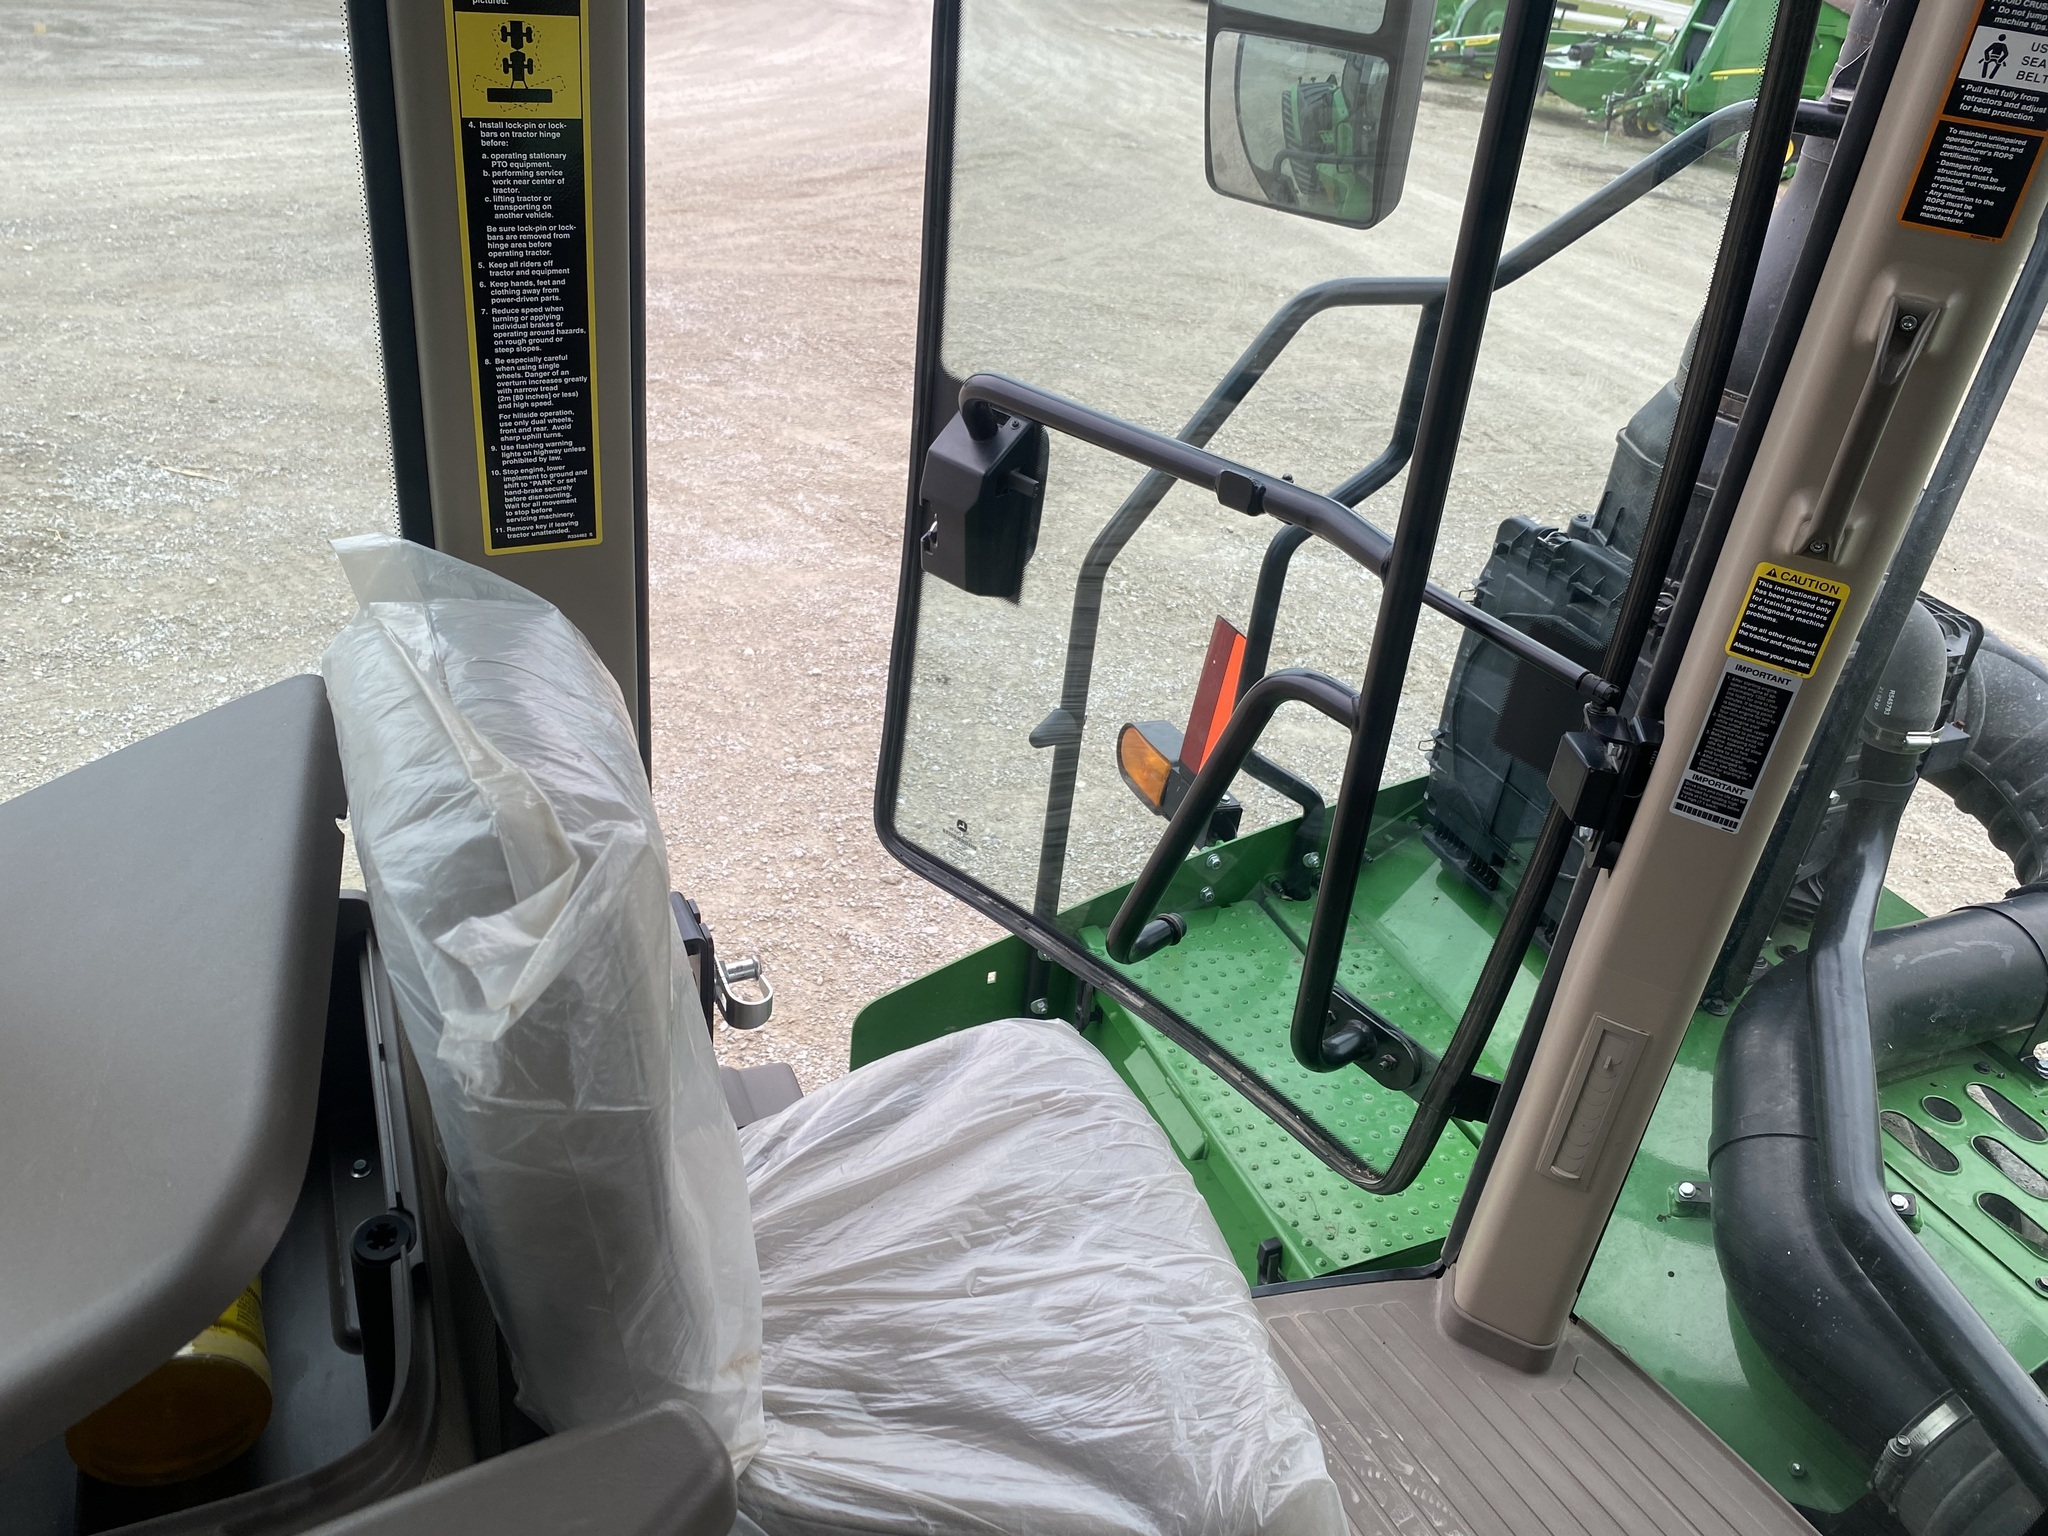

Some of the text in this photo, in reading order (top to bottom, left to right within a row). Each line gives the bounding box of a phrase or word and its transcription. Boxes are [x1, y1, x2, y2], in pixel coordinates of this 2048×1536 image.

[2023, 0, 2048, 10] CRUS
[1998, 6, 2010, 14] Do
[2025, 11, 2048, 22] jump
[1994, 17, 2048, 31] machine tips.
[2031, 42, 2048, 53] US
[2021, 56, 2046, 68] SEA
[1966, 84, 2040, 102] Pull belt fully from
[1963, 95, 2003, 106] retractors
[2021, 105, 2047, 114] adjust
[1972, 105, 1991, 114] best
[1991, 110, 2035, 122] protection.
[505, 122, 536, 130] lock-pin
[539, 131, 561, 139] hinge
[1958, 130, 1988, 139] maintain
[1988, 135, 2028, 146] unimpaired
[1945, 136, 1975, 145] operator
[1974, 141, 2010, 151] protection
[1940, 151, 1981, 162] certification:
[1942, 144, 2014, 160] manufacturer's ROPS
[492, 170, 534, 178] performing
[1926, 196, 1946, 205] ROPS
[494, 204, 541, 212] transporting
[1922, 205, 1954, 214] approved
[1920, 212, 1964, 224] manufacturer.
[488, 250, 524, 258] operating
[531, 268, 570, 276] equipment
[491, 296, 539, 305] power-driven
[503, 474, 540, 483] implement
[549, 471, 574, 479] ground
[531, 528, 570, 536] unattended.
[1780, 572, 1840, 595] CAUTION
[1759, 580, 1773, 589] This
[1774, 585, 1819, 601] instructional
[1768, 591, 1785, 600] been
[1785, 598, 1816, 609] provided
[1816, 606, 1831, 614] only
[1746, 610, 1778, 623] problems.
[1758, 605, 1795, 621] diagnosing
[1796, 617, 1825, 628] machine
[1764, 599, 1792, 612] training
[1793, 608, 1827, 621] operators
[1741, 622, 1758, 632] Keep
[1768, 631, 1786, 639] other
[1786, 637, 1806, 645] riders
[1733, 642, 1754, 652] Always
[1749, 633, 1770, 642] tractor
[1782, 644, 1816, 656] equipment.
[1735, 664, 1792, 686] IMPORTANT
[1692, 774, 1746, 796] IMPORTANT
